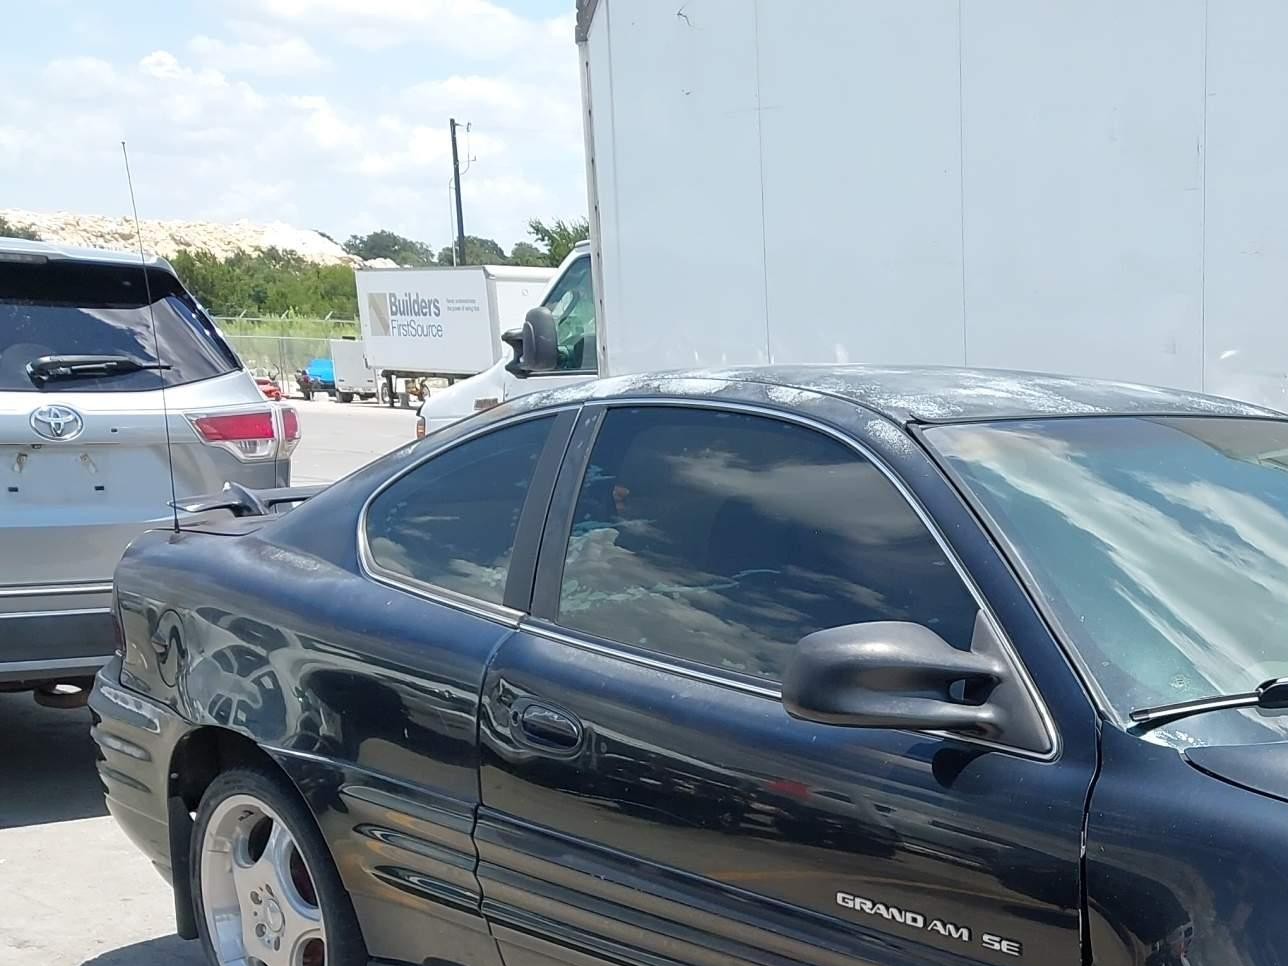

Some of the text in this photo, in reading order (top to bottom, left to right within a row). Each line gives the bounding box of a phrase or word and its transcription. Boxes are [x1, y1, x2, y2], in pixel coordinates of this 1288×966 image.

[388, 292, 441, 317] Builders
[391, 319, 443, 338] FirstSource
[836, 892, 1021, 957] GRAND AM SE
